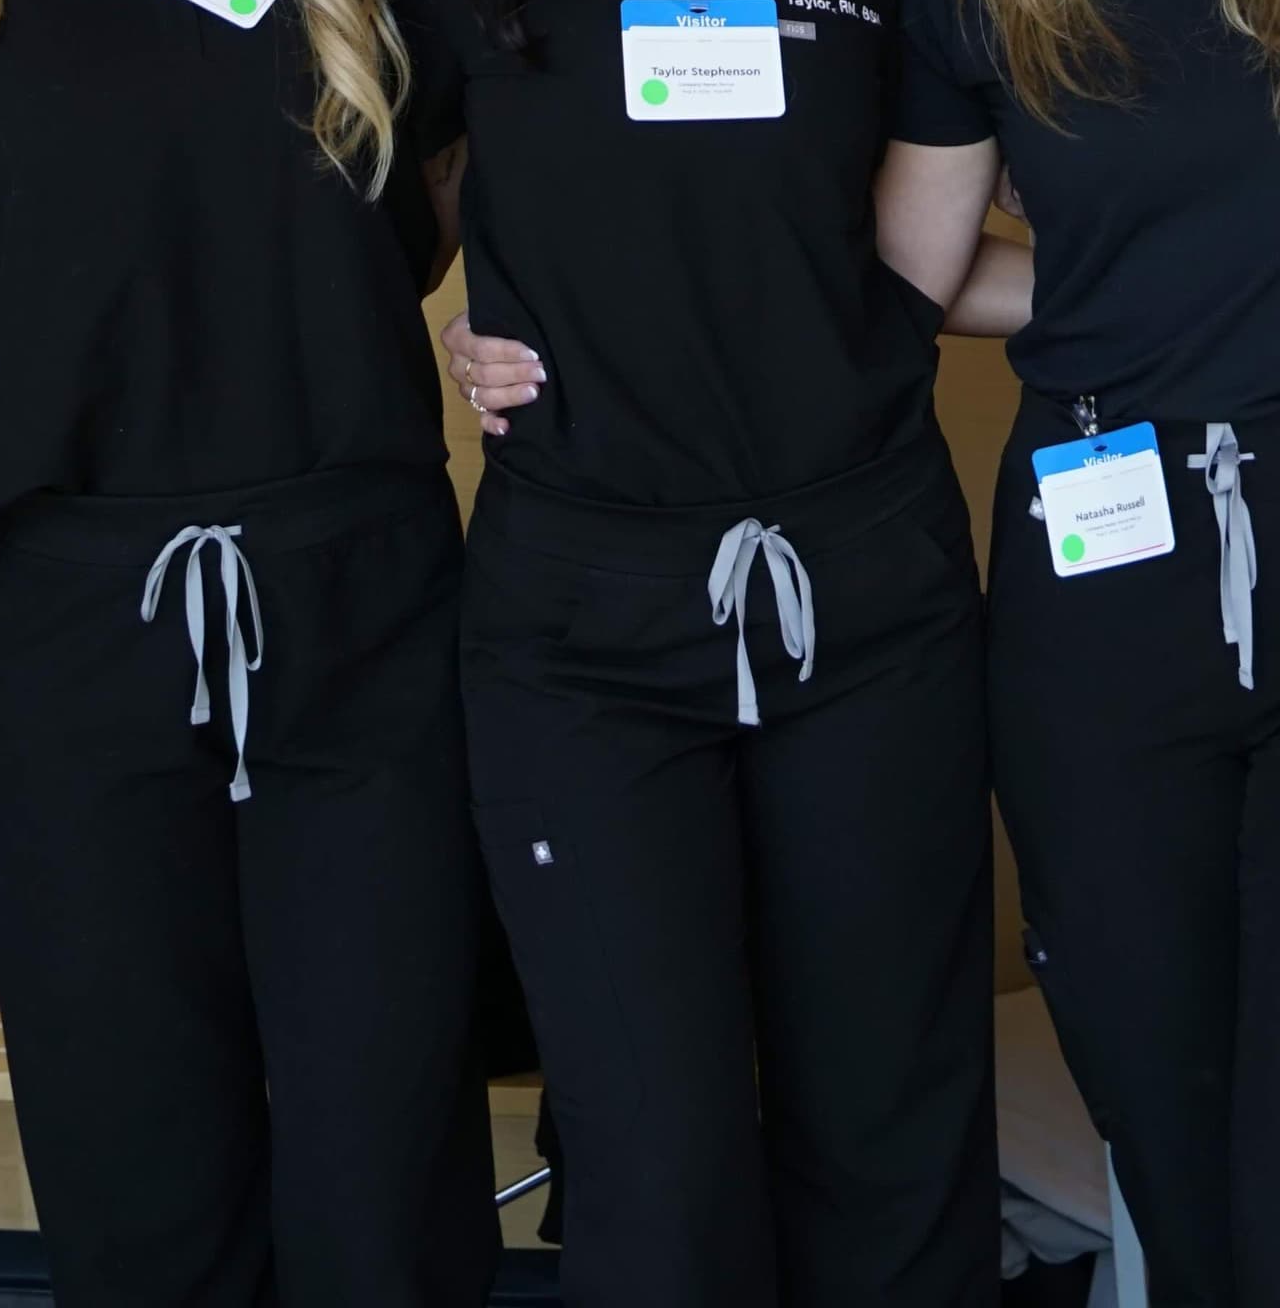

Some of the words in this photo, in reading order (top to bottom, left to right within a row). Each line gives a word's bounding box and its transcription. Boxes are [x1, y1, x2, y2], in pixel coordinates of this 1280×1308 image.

[676, 14, 727, 28] Visitor
[652, 66, 688, 79] Taylor
[691, 66, 761, 79] Stephenson
[1075, 506, 1115, 522] Natasha
[1117, 496, 1146, 512] Russell
